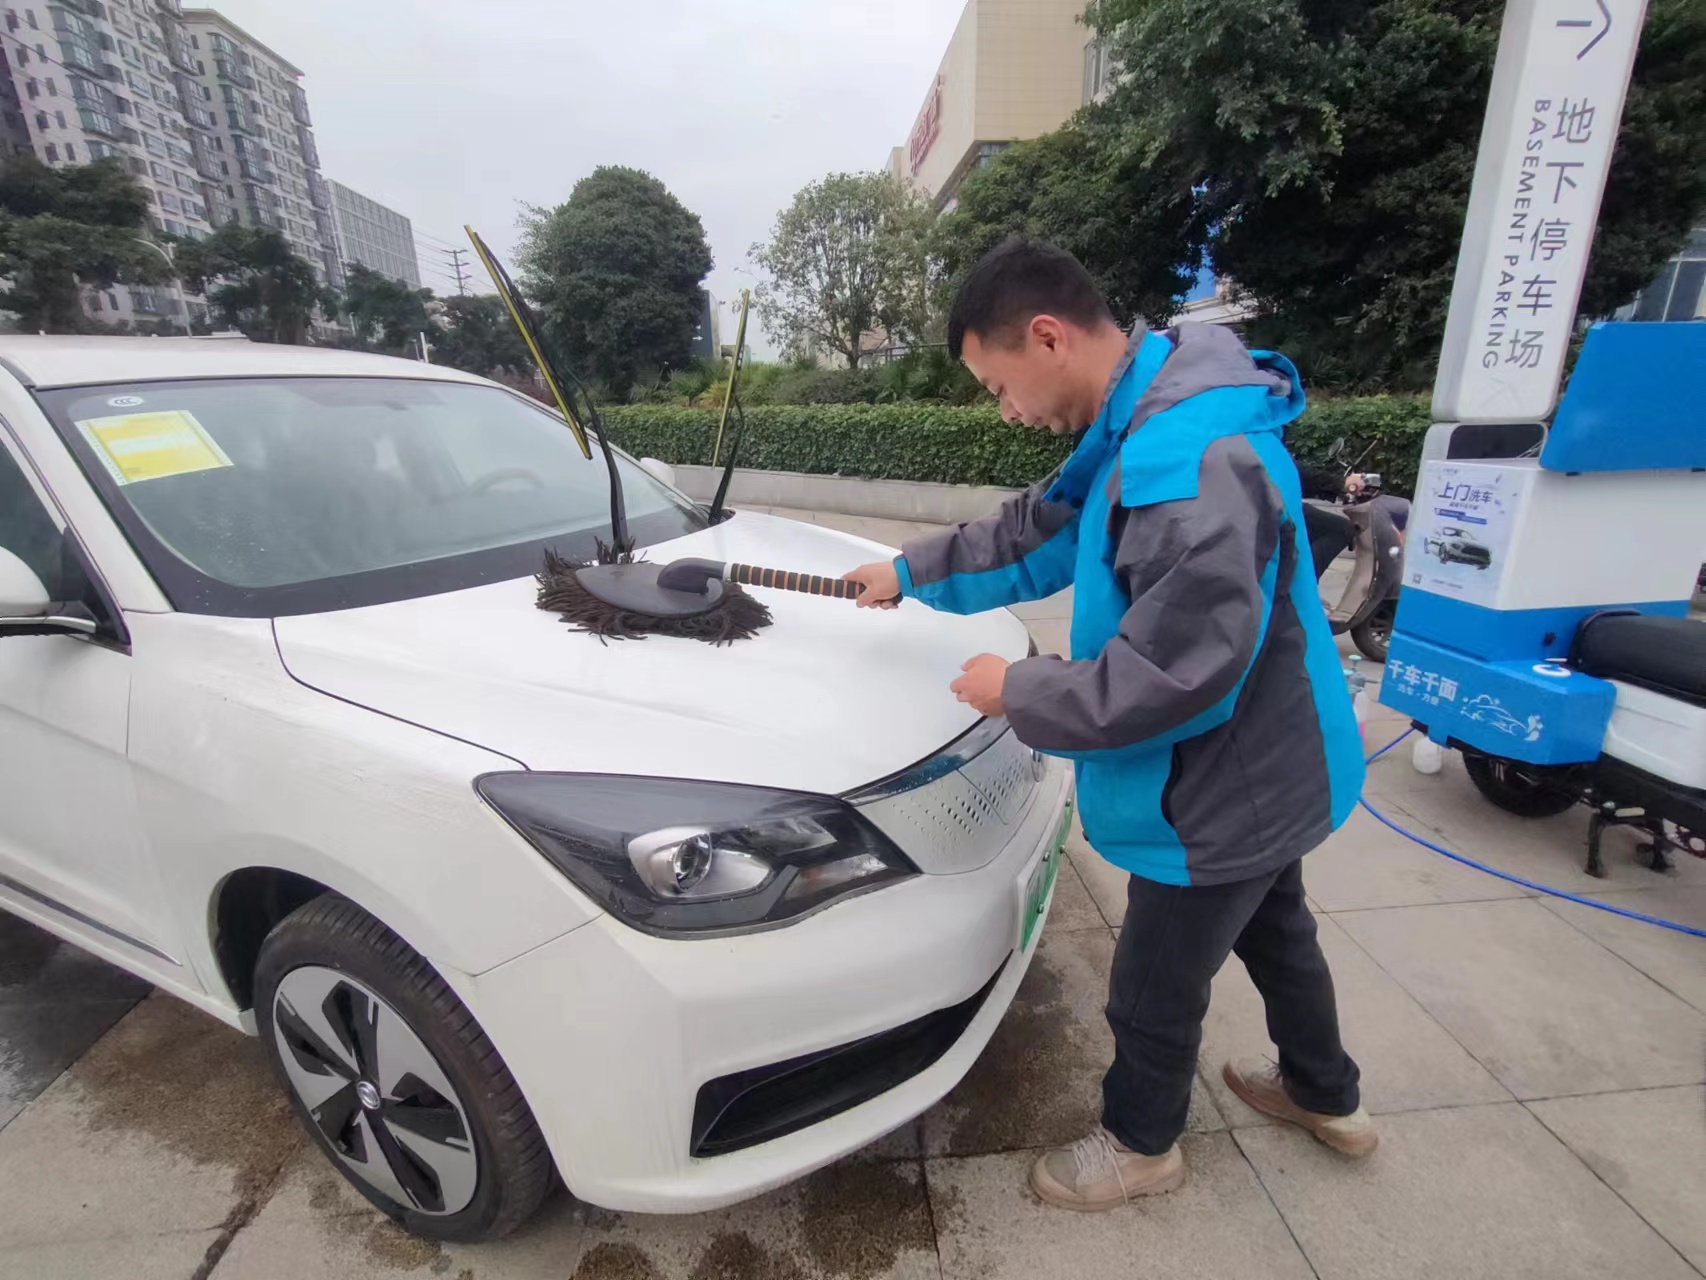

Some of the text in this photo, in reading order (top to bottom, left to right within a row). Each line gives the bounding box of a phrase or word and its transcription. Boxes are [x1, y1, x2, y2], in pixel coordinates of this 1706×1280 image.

[1482, 99, 1551, 369] BASEMENT PARKING
[1504, 97, 1596, 367] 地下停车场
[1437, 482, 1493, 502] 上门洗车
[1388, 659, 1458, 701] 千车千面
